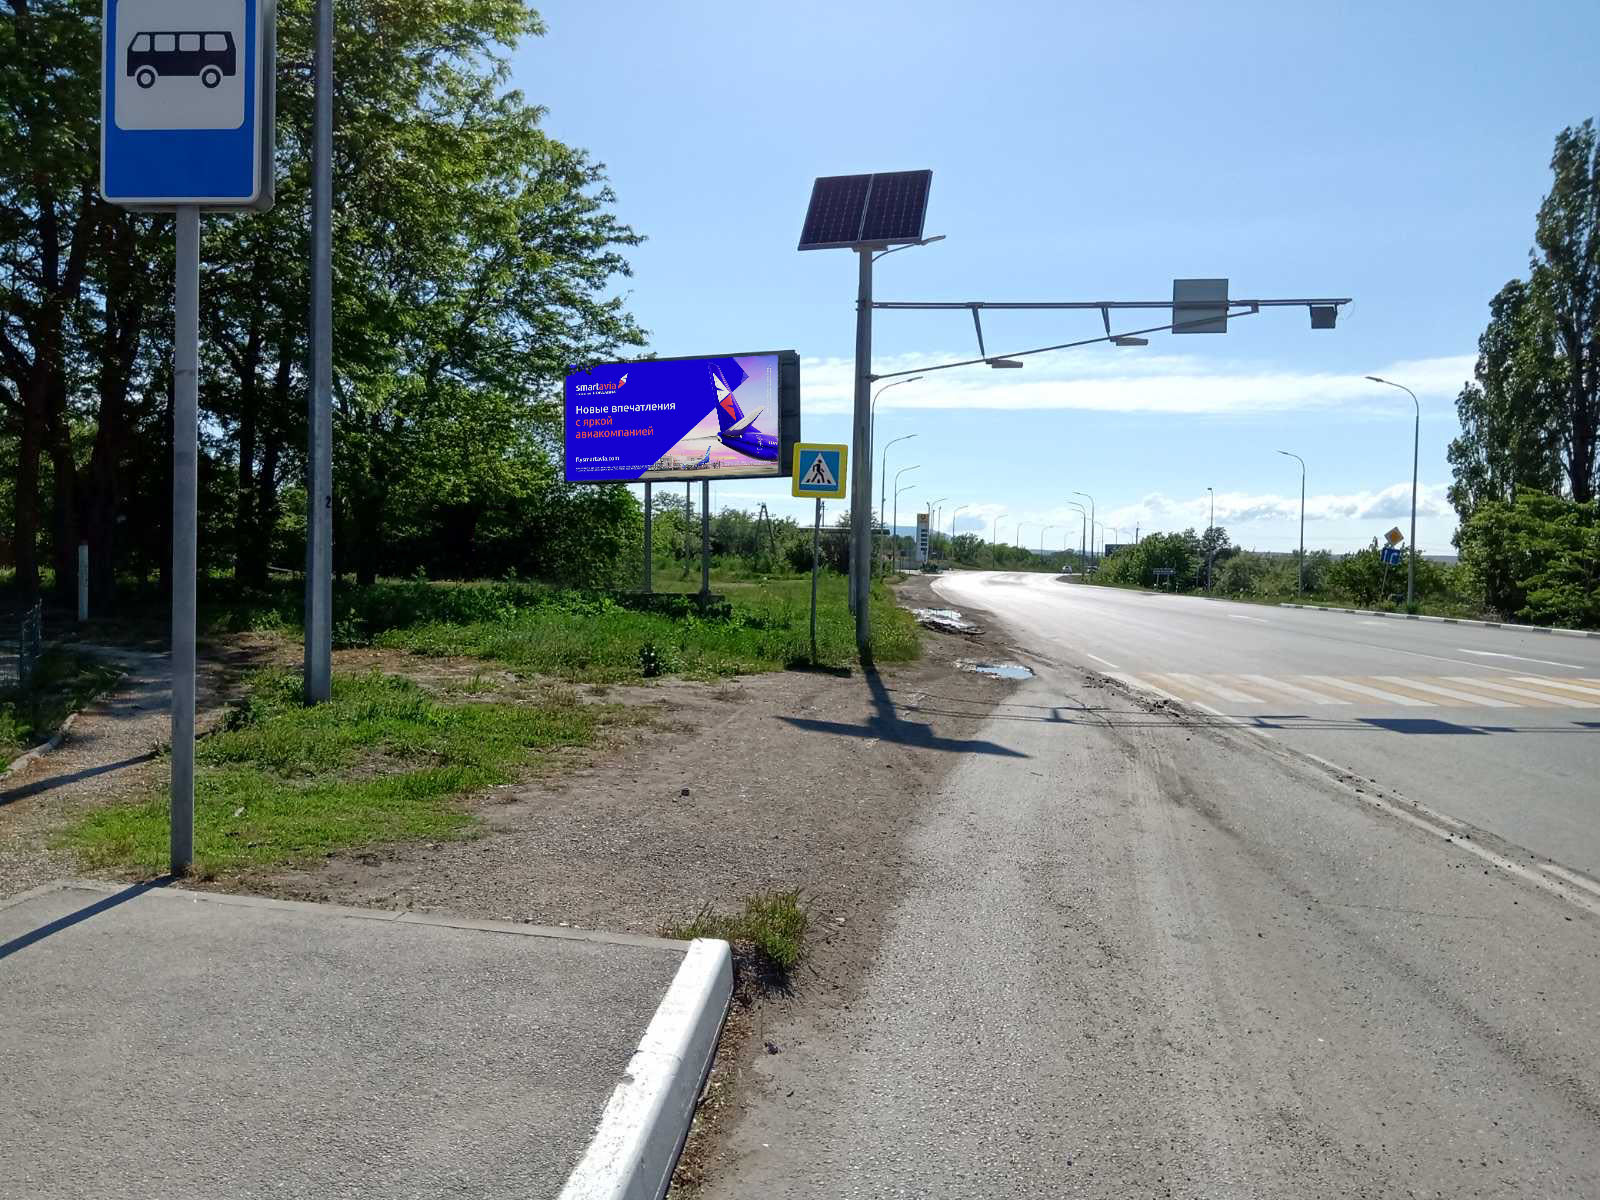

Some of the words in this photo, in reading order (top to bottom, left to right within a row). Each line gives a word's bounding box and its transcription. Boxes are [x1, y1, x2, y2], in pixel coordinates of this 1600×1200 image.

[575, 382, 617, 391] smartavia
[575, 405, 609, 414] Новые
[611, 402, 676, 413] впечатления
[575, 419, 581, 427] с
[583, 416, 613, 427] яркой
[575, 426, 654, 438] авиакомпанией
